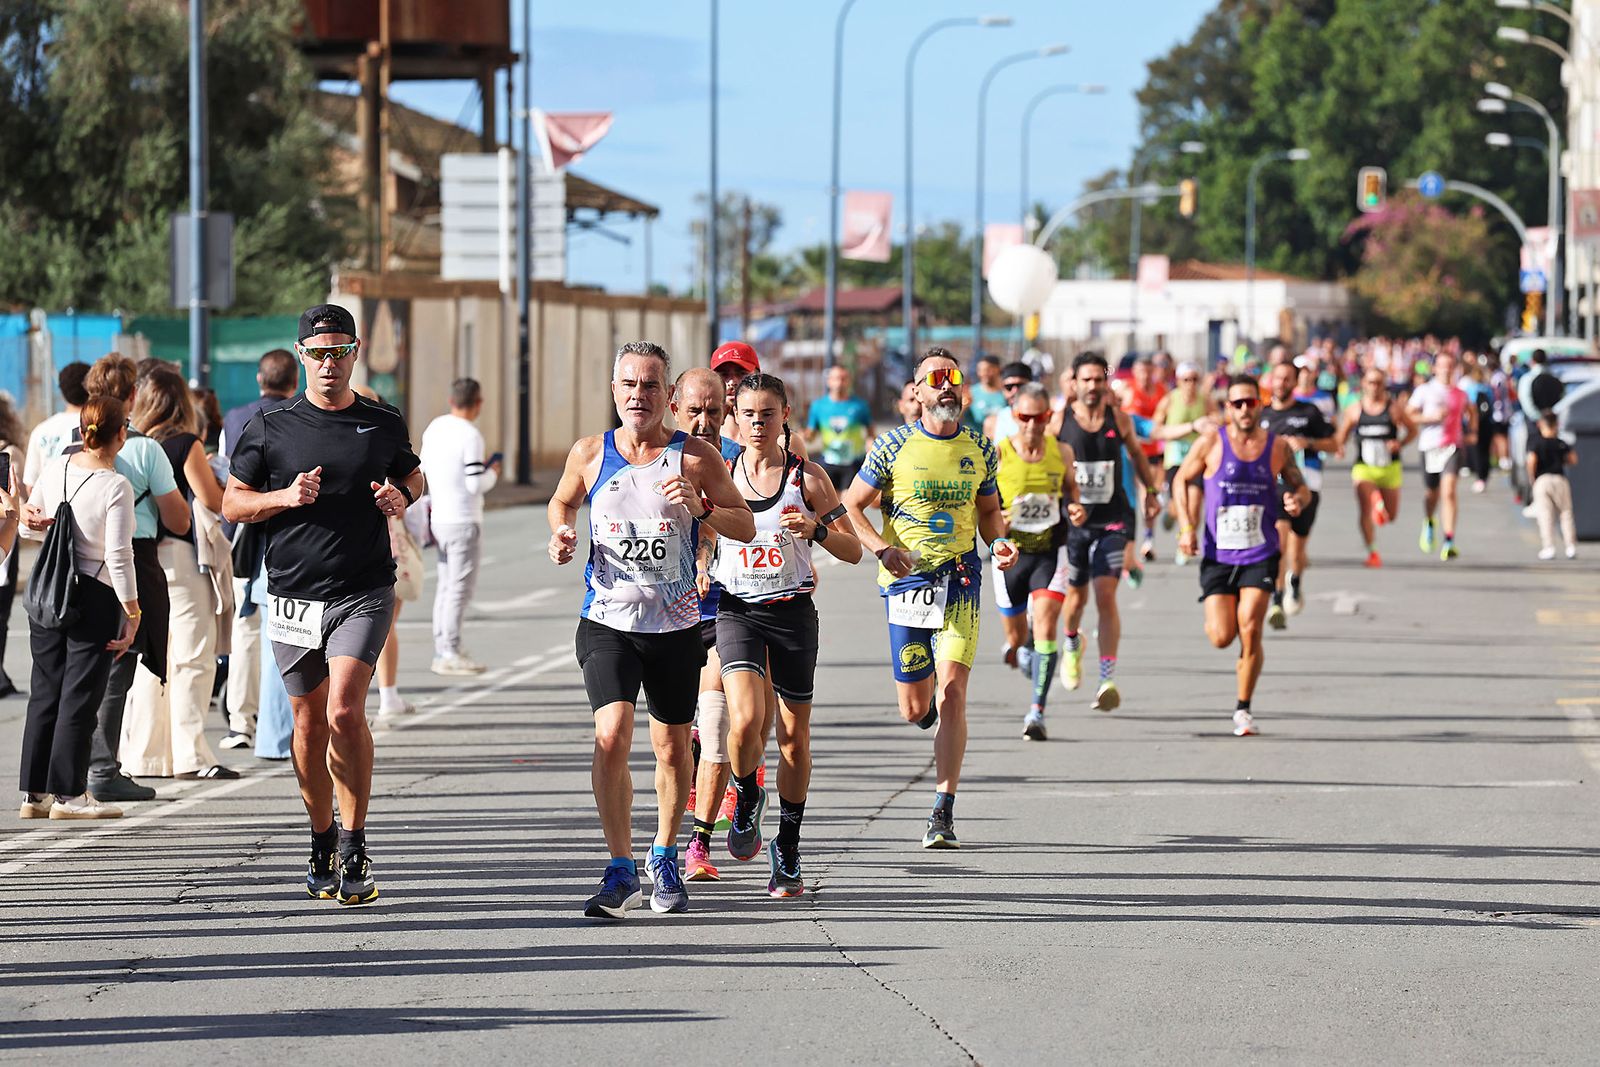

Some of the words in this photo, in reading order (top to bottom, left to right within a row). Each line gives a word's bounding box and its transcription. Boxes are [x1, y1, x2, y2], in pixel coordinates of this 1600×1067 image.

[913, 480, 959, 490] CANILLAS
[961, 481, 973, 490] DE
[912, 489, 971, 501] ALBAIDA
[1020, 504, 1050, 518] 225
[619, 538, 667, 561] 226
[738, 547, 783, 568] 126
[902, 587, 935, 606] 170
[273, 596, 311, 622] 107
